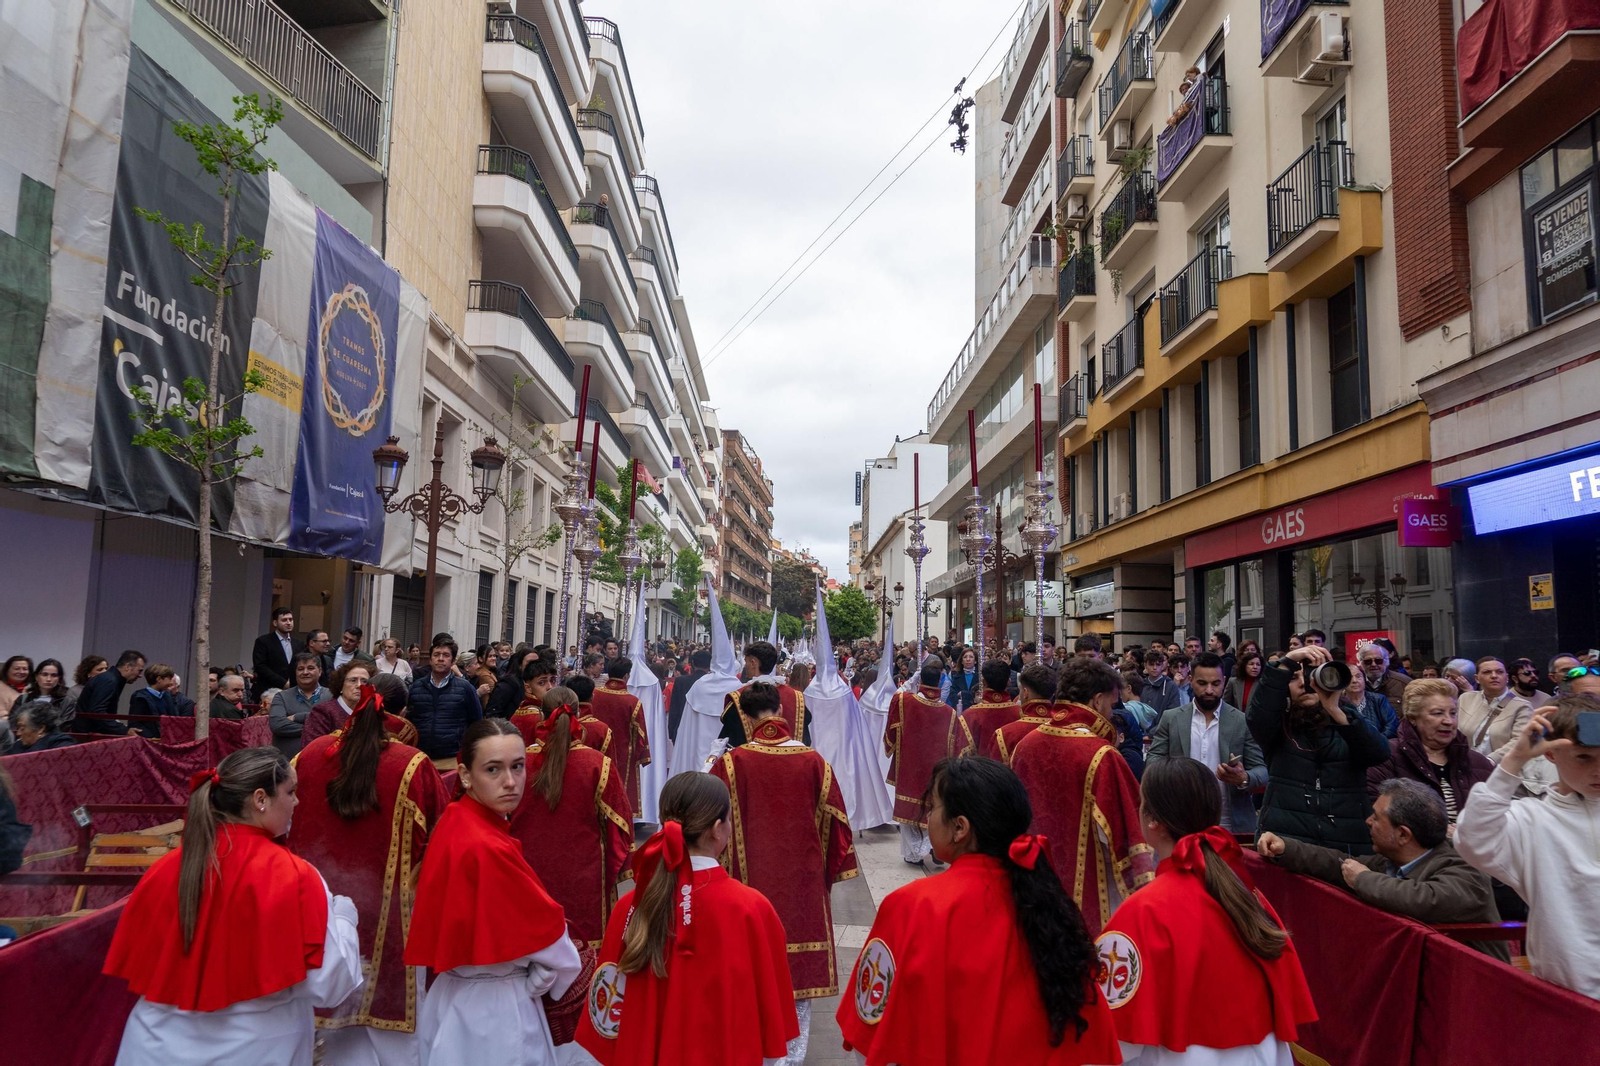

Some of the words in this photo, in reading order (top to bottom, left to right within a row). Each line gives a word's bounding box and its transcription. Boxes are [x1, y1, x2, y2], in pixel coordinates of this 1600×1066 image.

[1540, 216, 1552, 235] SE
[1553, 193, 1588, 226] VENDE
[1546, 256, 1589, 285] BOMBEROS
[1551, 249, 1582, 270] ACCESO
[342, 336, 365, 355] TRAMOS
[333, 347, 340, 358] DE
[343, 354, 371, 376] CUARESMA
[1569, 466, 1600, 502] FE
[1261, 508, 1305, 545] GAES
[1408, 513, 1448, 527] GAES
